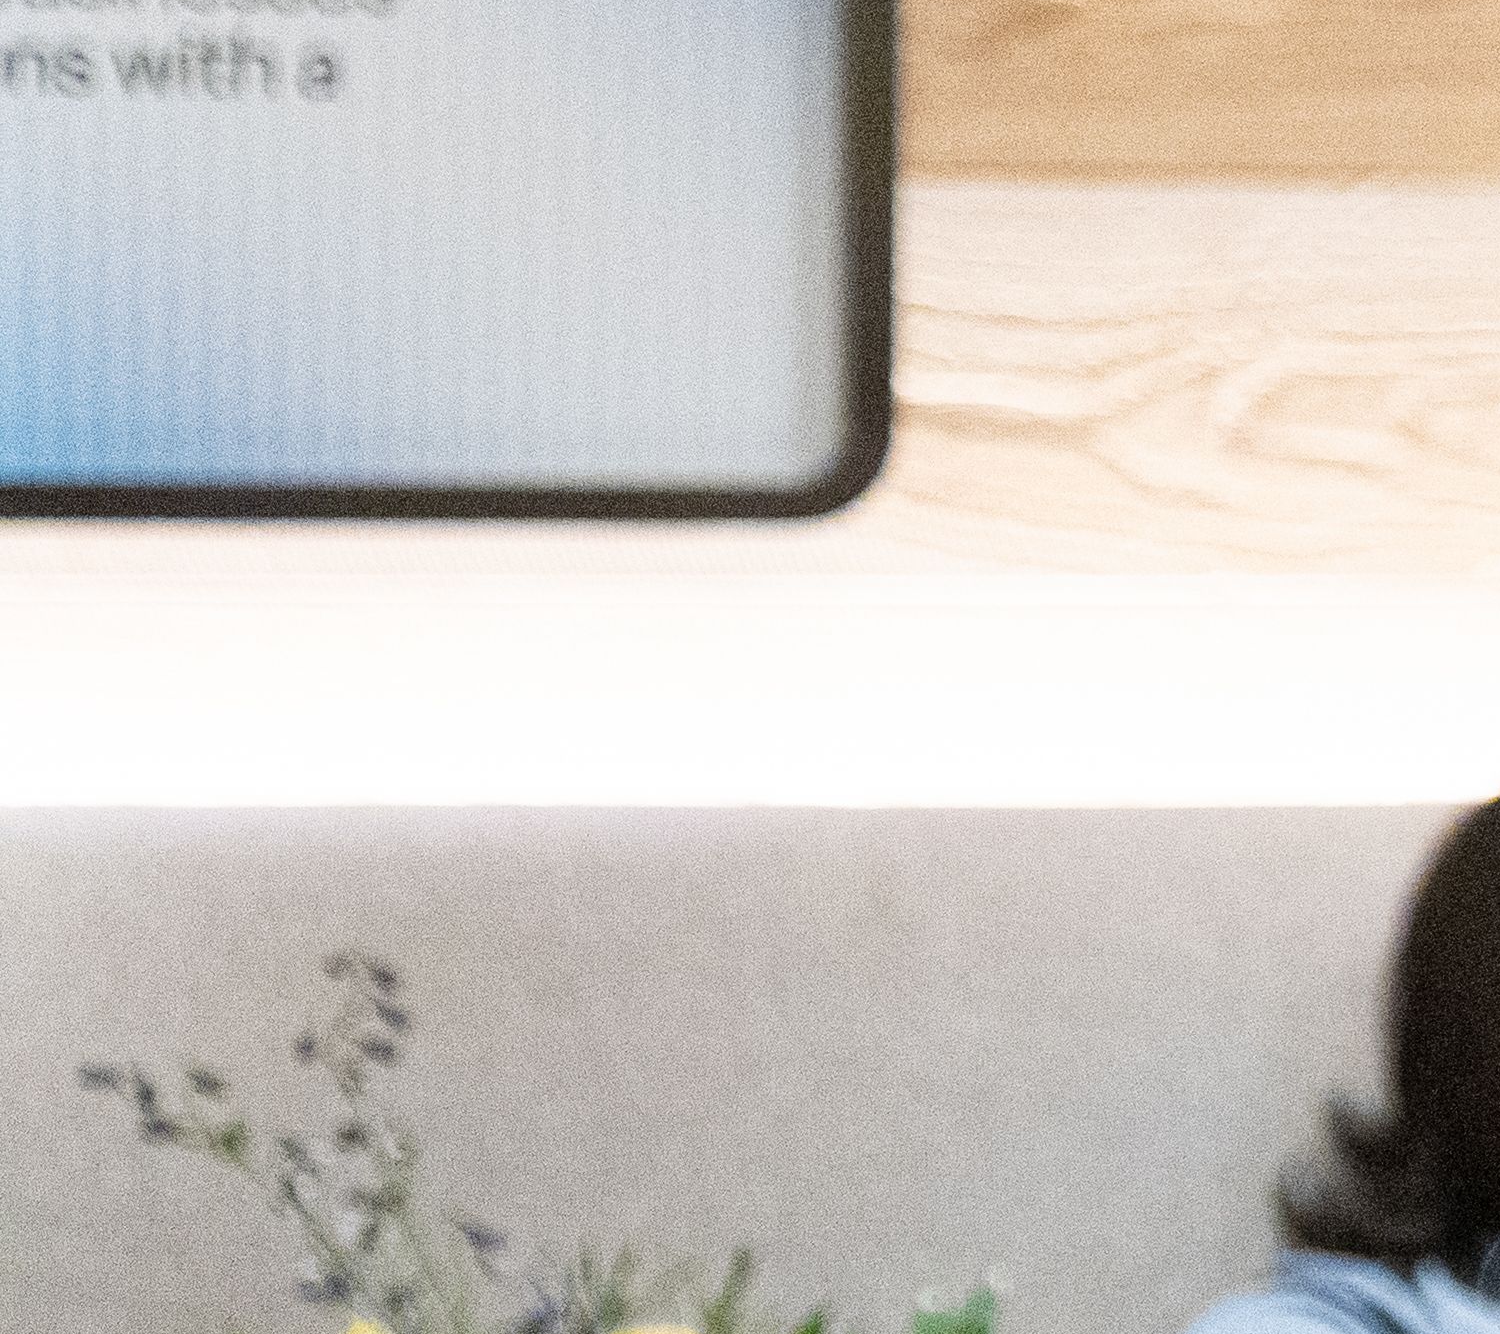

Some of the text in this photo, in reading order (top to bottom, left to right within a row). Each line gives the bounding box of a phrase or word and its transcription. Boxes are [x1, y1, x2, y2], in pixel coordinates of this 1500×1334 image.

[0, 33, 344, 97] ns with a
